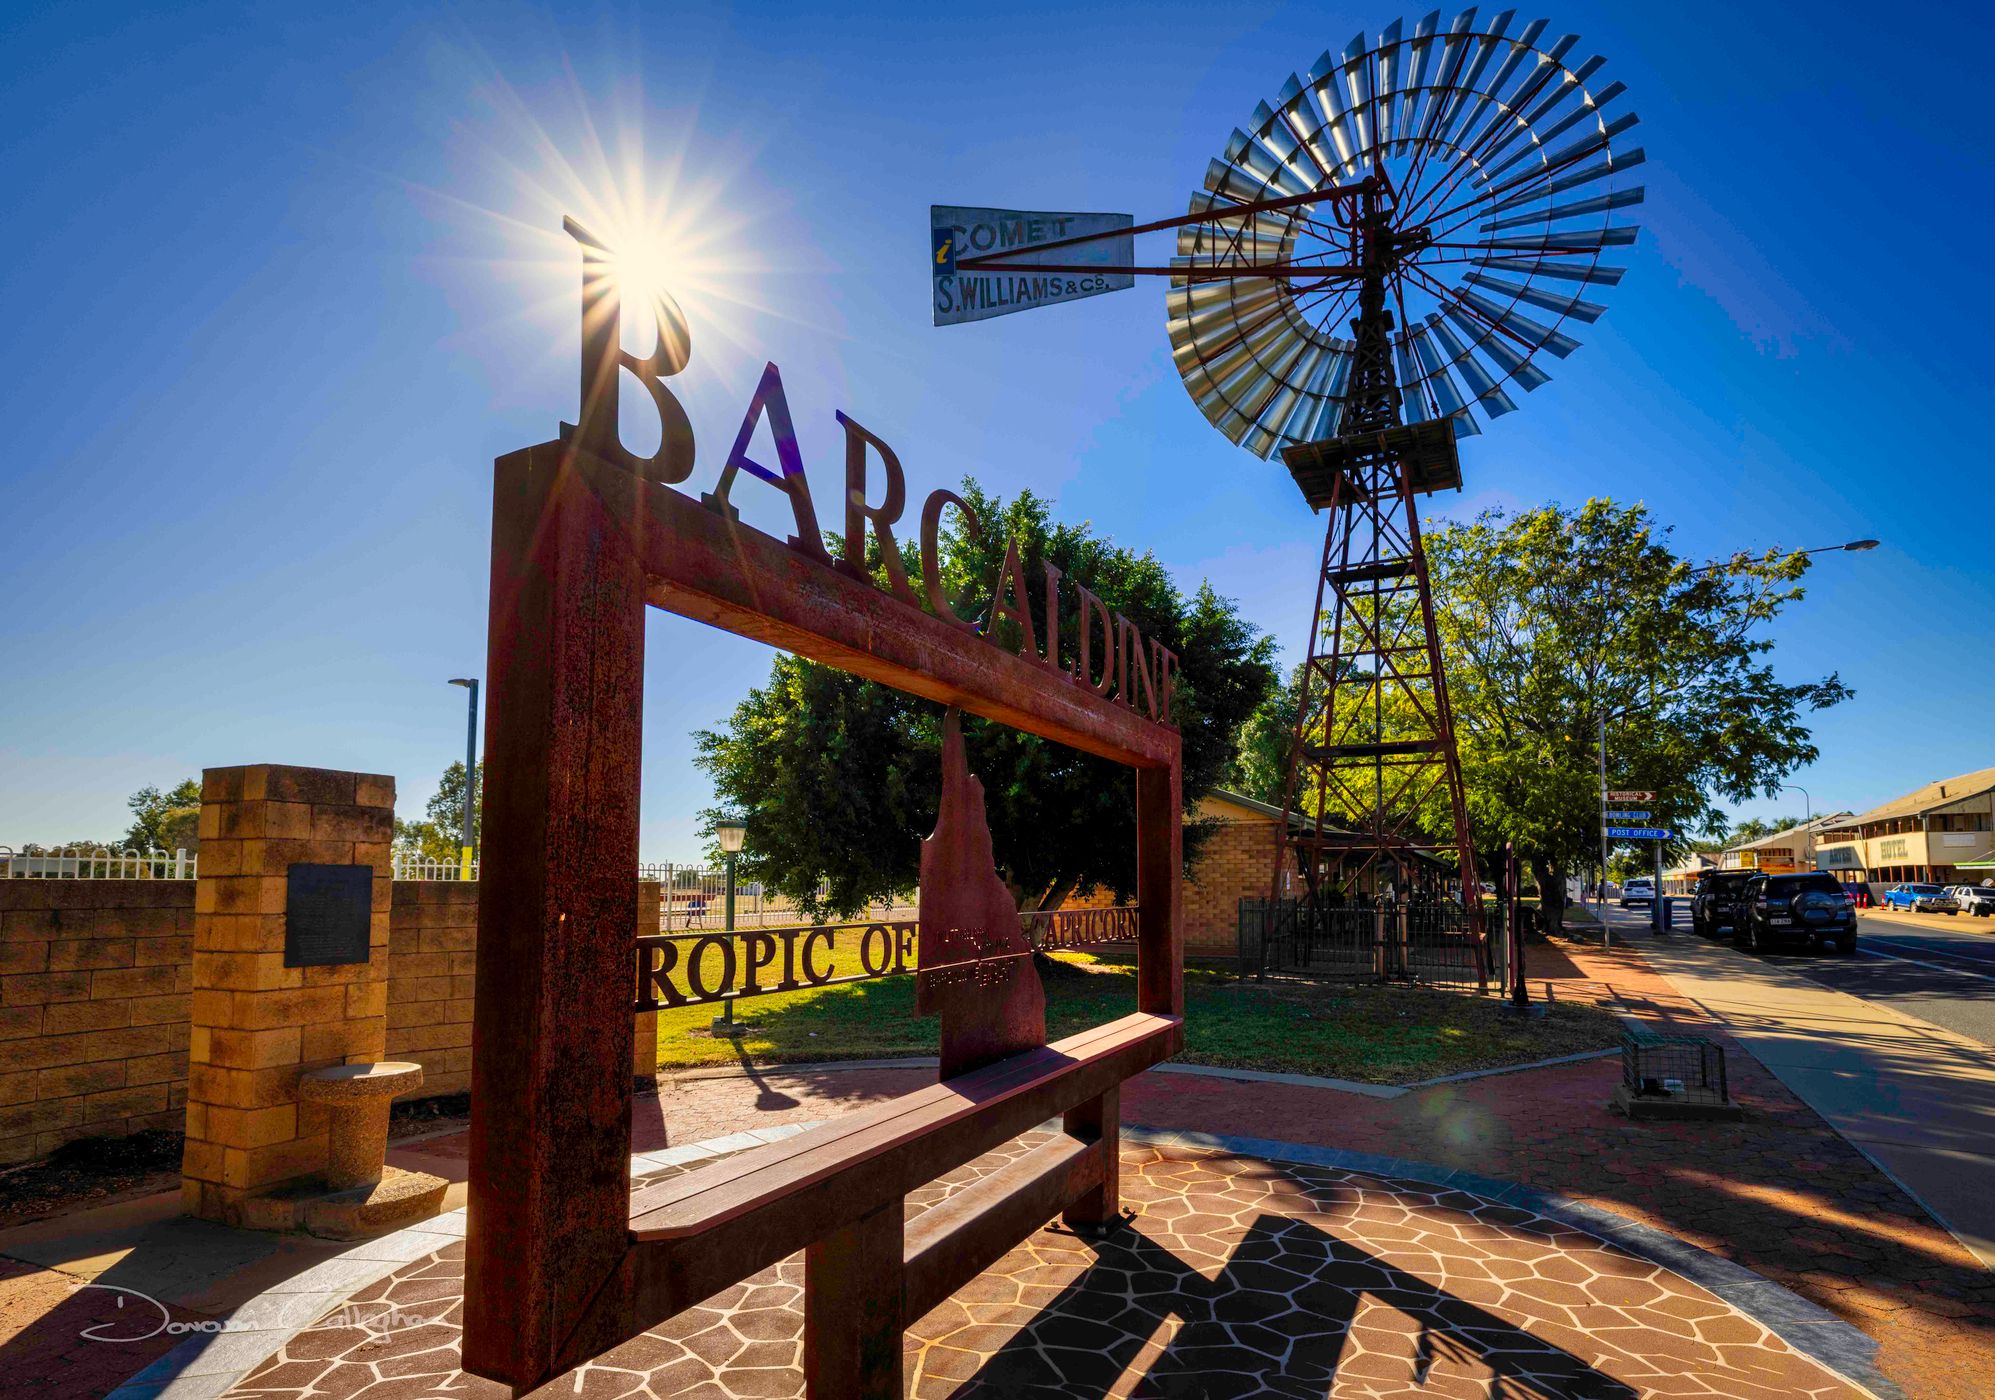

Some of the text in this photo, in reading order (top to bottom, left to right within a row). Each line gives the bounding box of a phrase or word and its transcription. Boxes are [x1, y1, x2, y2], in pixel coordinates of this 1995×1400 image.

[952, 216, 1075, 256] COMET
[560, 215, 1180, 731] BARCALDINE
[633, 929, 834, 1012] ROPIC
[861, 923, 917, 976] OF
